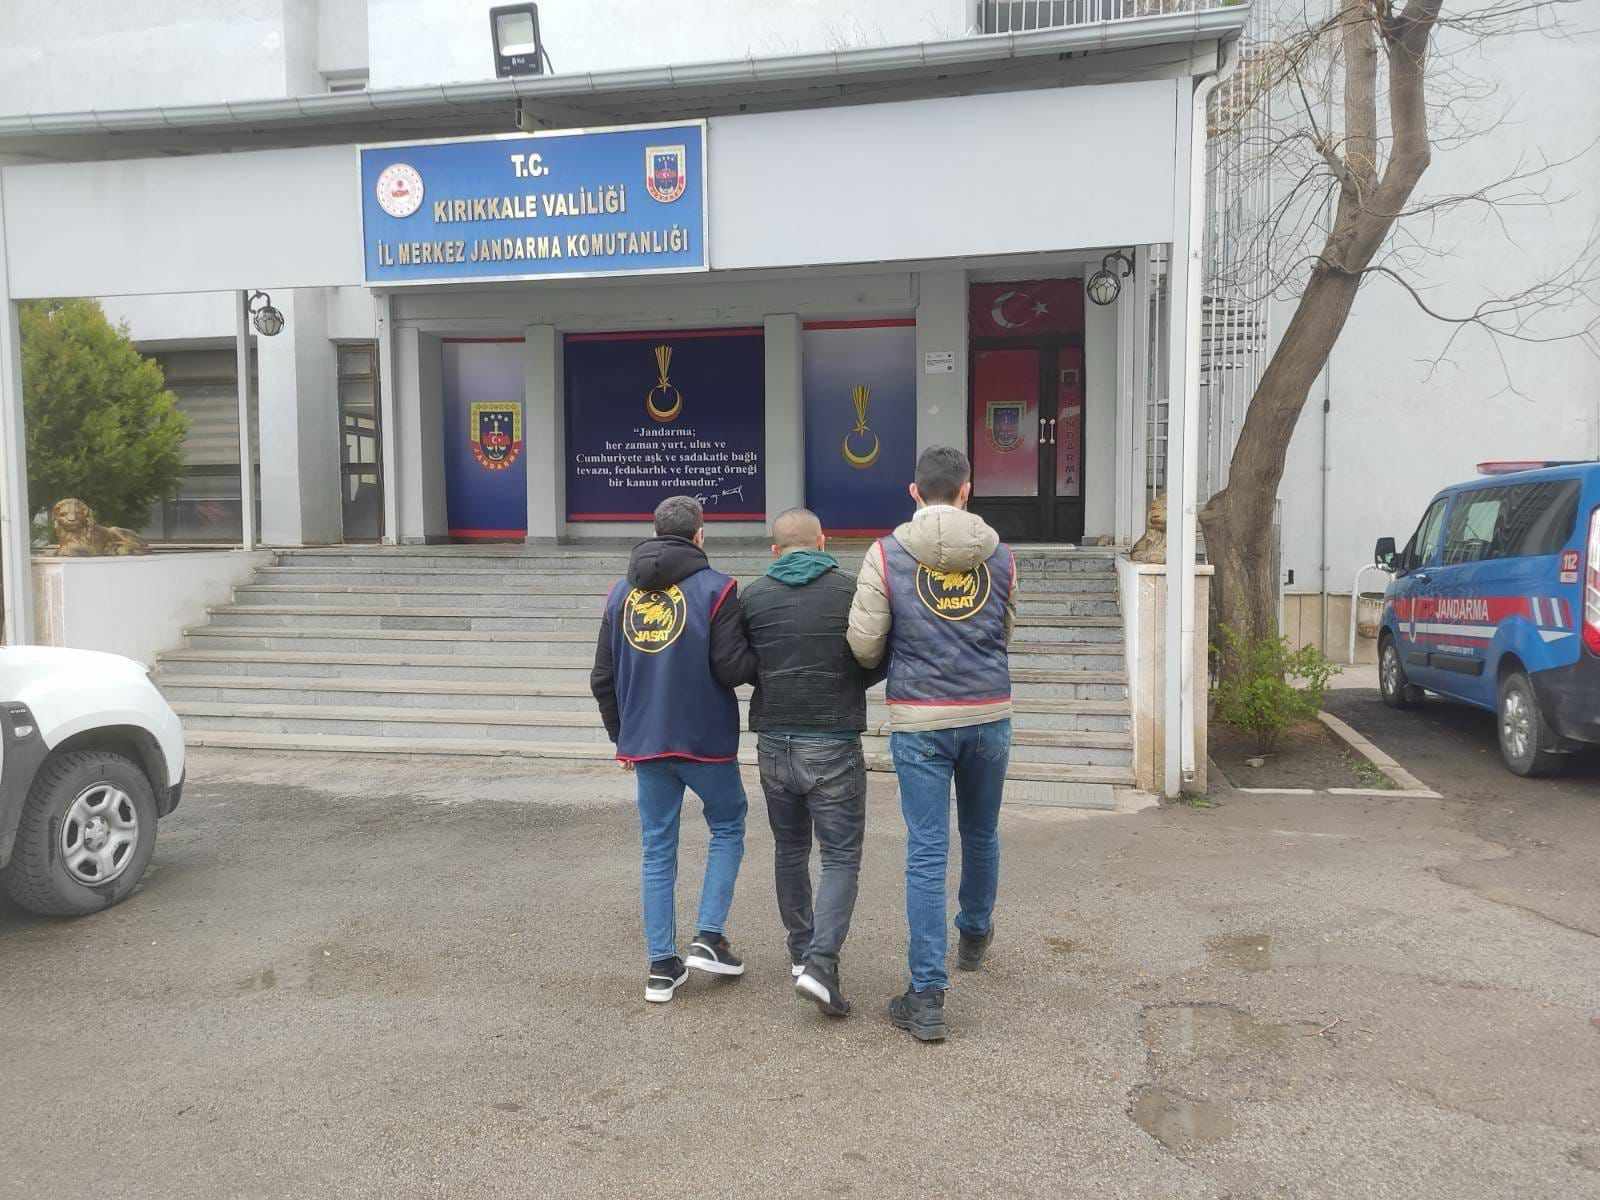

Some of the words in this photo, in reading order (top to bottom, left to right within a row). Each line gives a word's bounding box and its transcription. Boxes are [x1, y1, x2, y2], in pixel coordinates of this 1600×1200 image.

[511, 153, 549, 177] T.C.
[433, 195, 537, 222] KIRIKKALE
[543, 184, 626, 216] VALİLİĞİ
[378, 240, 394, 265] İL
[399, 240, 465, 265] MERKEZ
[470, 235, 562, 262] JANDARMA
[567, 224, 688, 257] KOMUTANLIĞI
[606, 441, 622, 450] her
[625, 442, 658, 450] zaman
[714, 441, 726, 449] ve
[576, 453, 642, 464] Cumhuriyete
[645, 453, 662, 463] aşk
[680, 452, 729, 461] sadakatle
[731, 451, 757, 463] bağlı
[615, 465, 667, 474] fedakarlık
[684, 465, 721, 475] feragat
[724, 464, 757, 476] örneği
[609, 478, 624, 487] bir
[626, 478, 659, 487] kanun
[937, 596, 974, 609] JASAT
[1435, 599, 1489, 621] JANDARMA
[634, 630, 670, 642] JASAT
